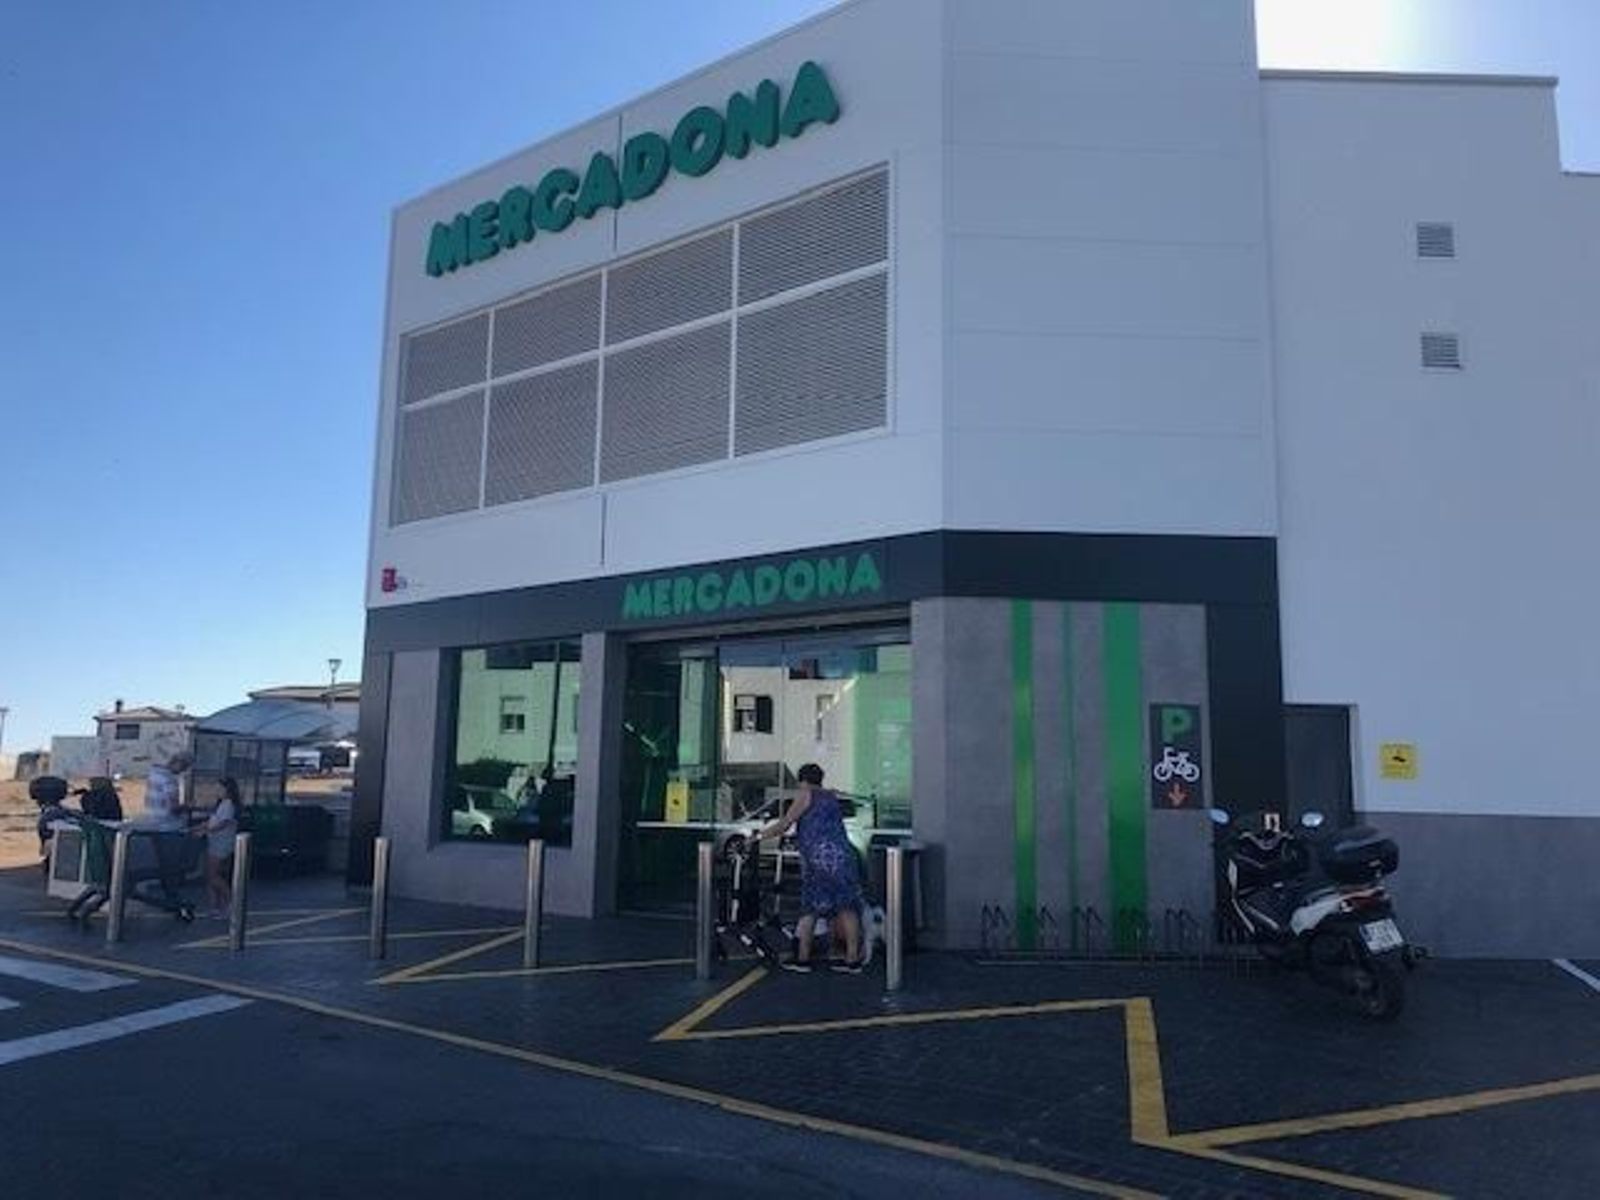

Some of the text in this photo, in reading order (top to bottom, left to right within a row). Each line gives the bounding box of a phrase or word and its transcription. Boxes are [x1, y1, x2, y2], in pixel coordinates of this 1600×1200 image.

[426, 60, 840, 277] MERCADONA
[623, 553, 880, 619] MERCADONA
[1161, 707, 1192, 744] P
